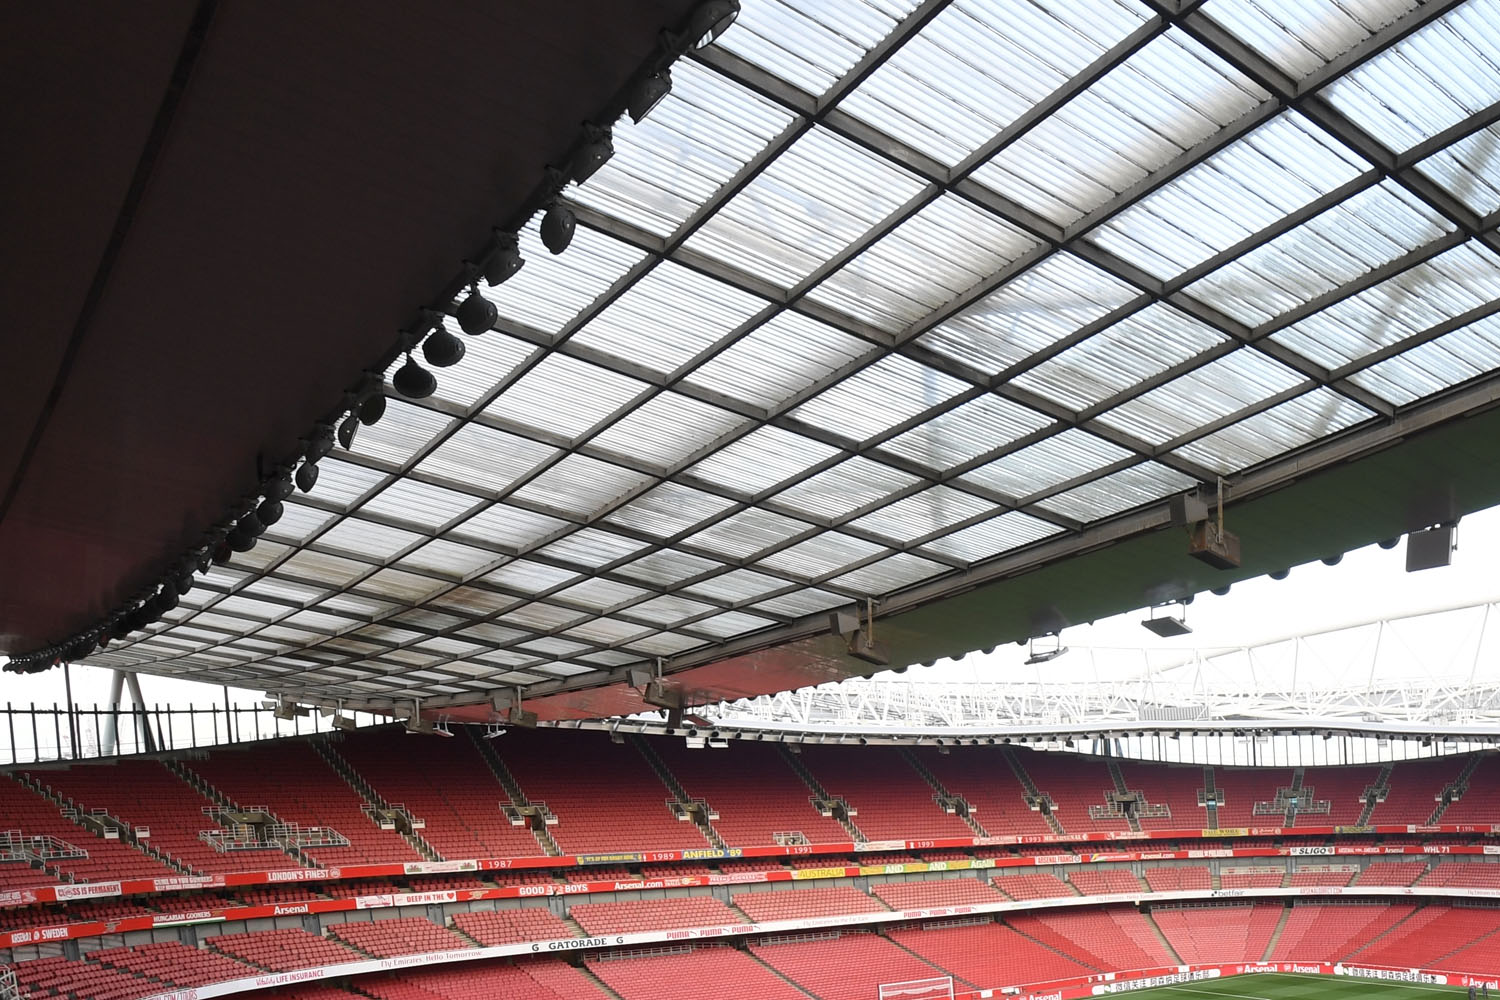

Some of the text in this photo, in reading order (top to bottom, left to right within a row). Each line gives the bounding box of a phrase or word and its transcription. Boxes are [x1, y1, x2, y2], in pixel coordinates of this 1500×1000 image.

[683, 848, 742, 859] ANFIELD '89
[488, 860, 512, 868] 1987
[885, 864, 904, 873] AND
[929, 862, 947, 871] AND
[268, 869, 329, 882] LONDON'S FINEST
[800, 868, 844, 878] AUSTRALIA
[88, 884, 121, 894] PERMANENT
[519, 883, 588, 896] GOOD BOYS
[614, 880, 663, 890] Arsenal.com
[406, 895, 423, 903] DEEP
[432, 893, 444, 901] THE
[274, 904, 308, 915] Arsenal
[153, 914, 185, 922] HUNGARIAN
[42, 928, 68, 939] SWEDEN
[667, 926, 754, 939] PUMA PUMA PUMA
[531, 936, 624, 951] G GATORADE G
[381, 960, 391, 968] Fly
[426, 953, 443, 961] Hello
[1244, 964, 1277, 973] Arsenal
[1292, 964, 1320, 973] Arsenal
[276, 974, 288, 983] LIFE
[289, 970, 324, 981] INSURANCE
